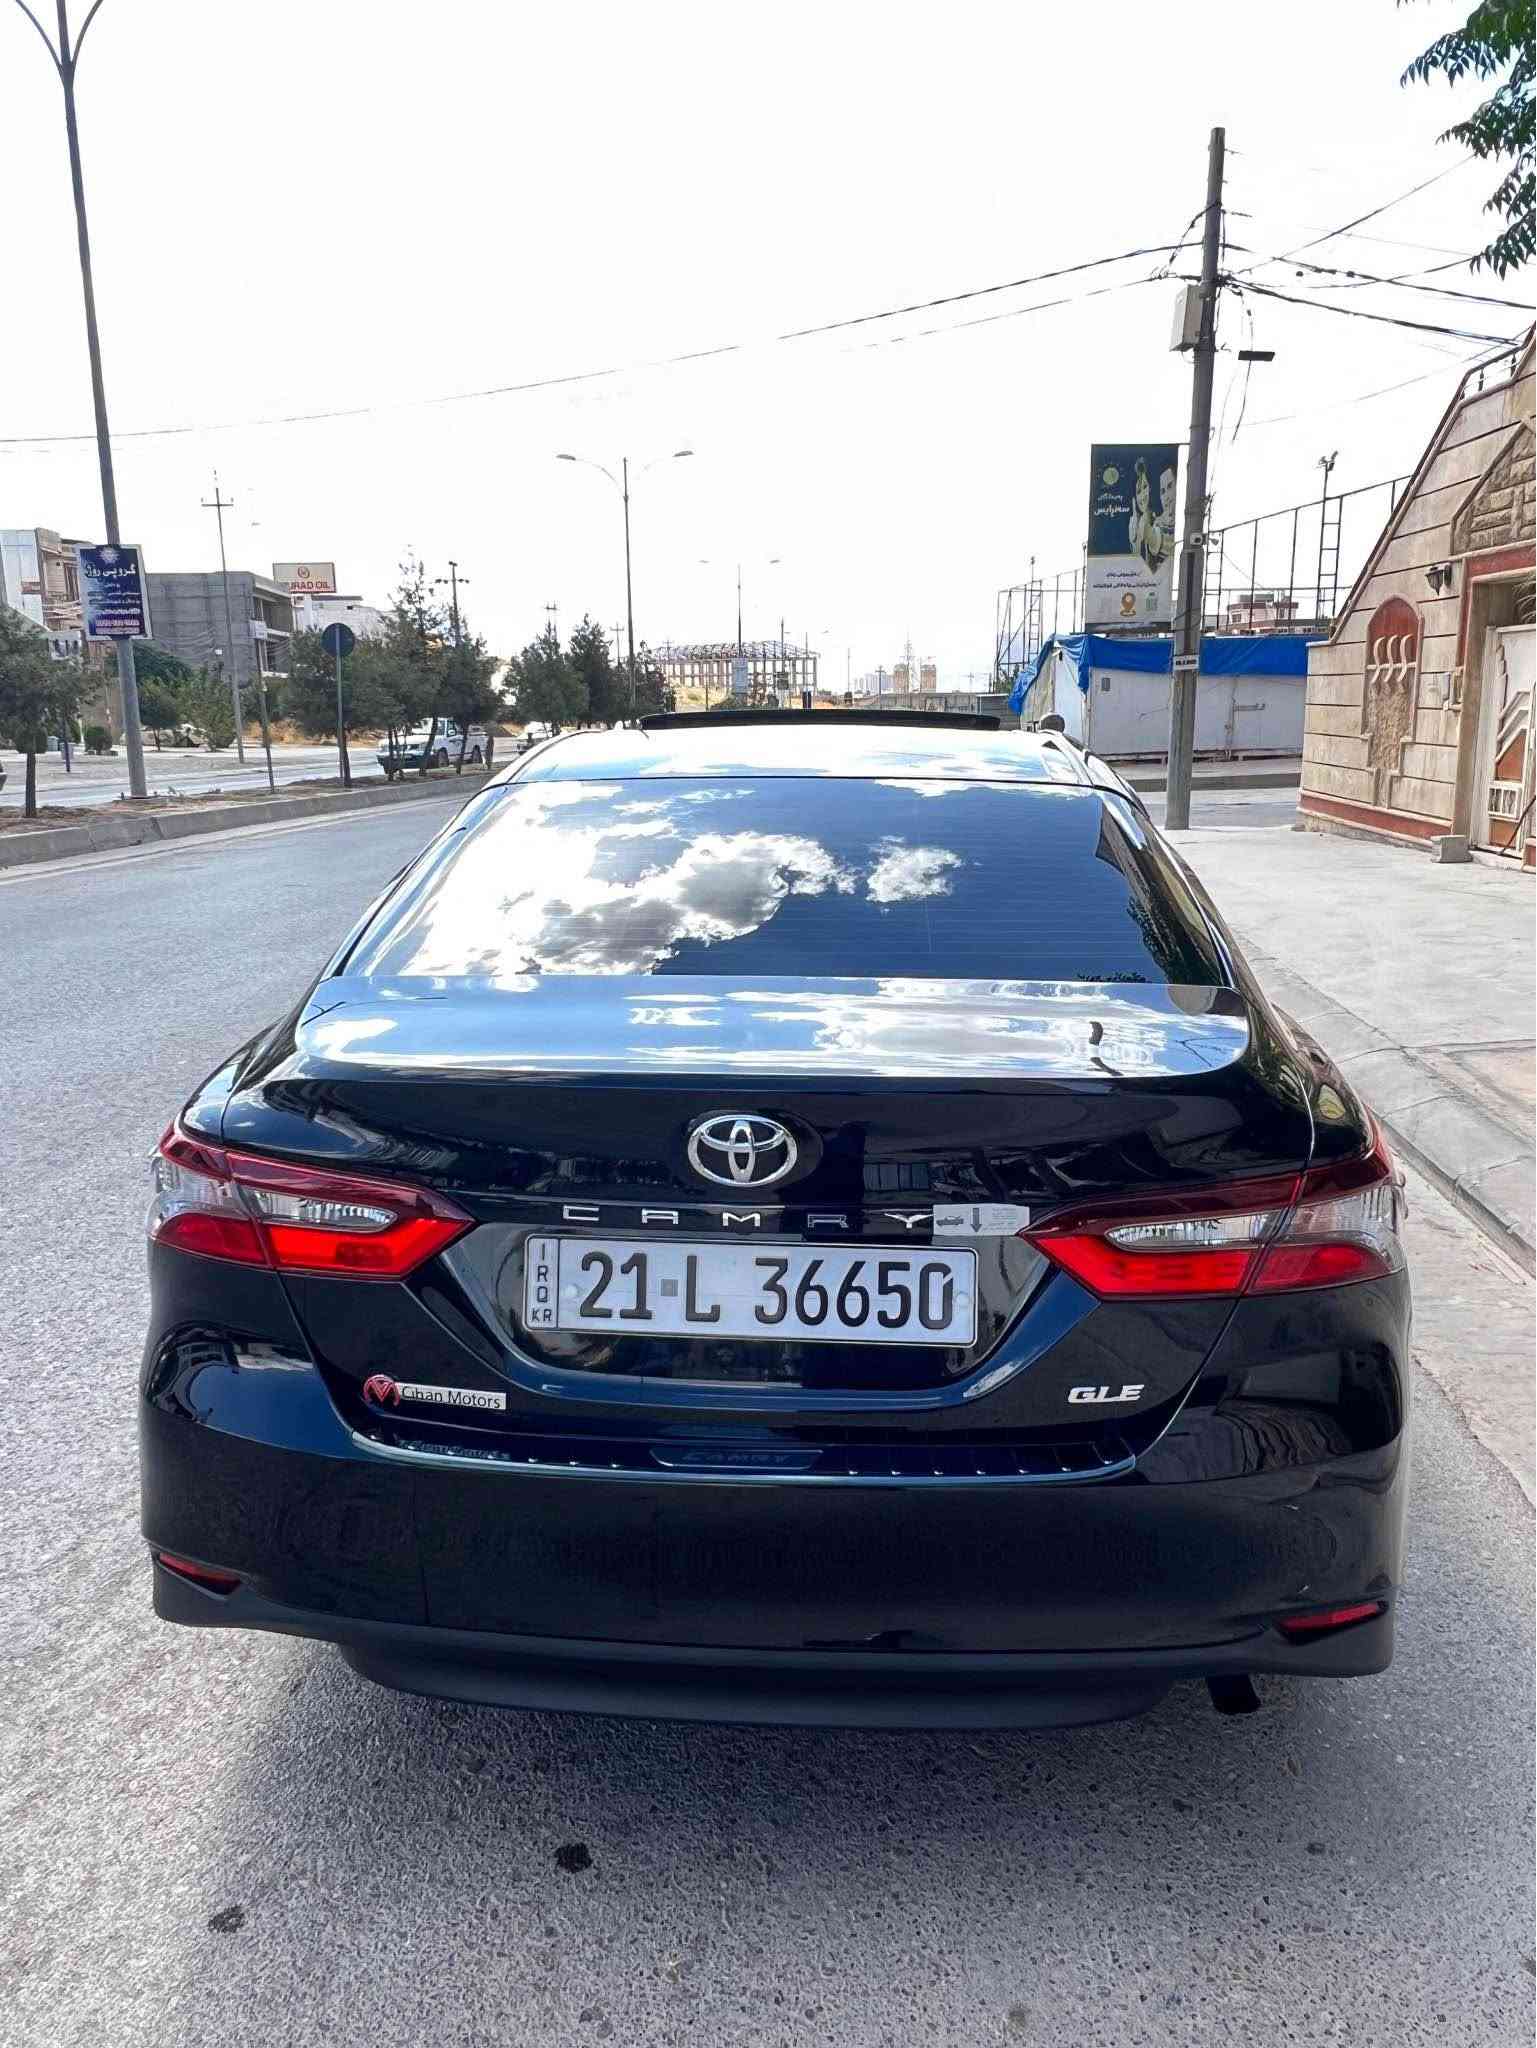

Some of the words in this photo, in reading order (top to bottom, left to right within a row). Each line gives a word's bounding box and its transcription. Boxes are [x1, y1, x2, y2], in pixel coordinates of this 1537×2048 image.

[562, 1203, 934, 1229] CAMRY
[579, 1251, 652, 1320] 21
[685, 1255, 721, 1323] L
[754, 1257, 954, 1330] 36650
[531, 1308, 552, 1322] KR
[402, 1386, 443, 1402] Cihan
[447, 1390, 502, 1409] Motors
[1067, 1384, 1145, 1404] GLE
